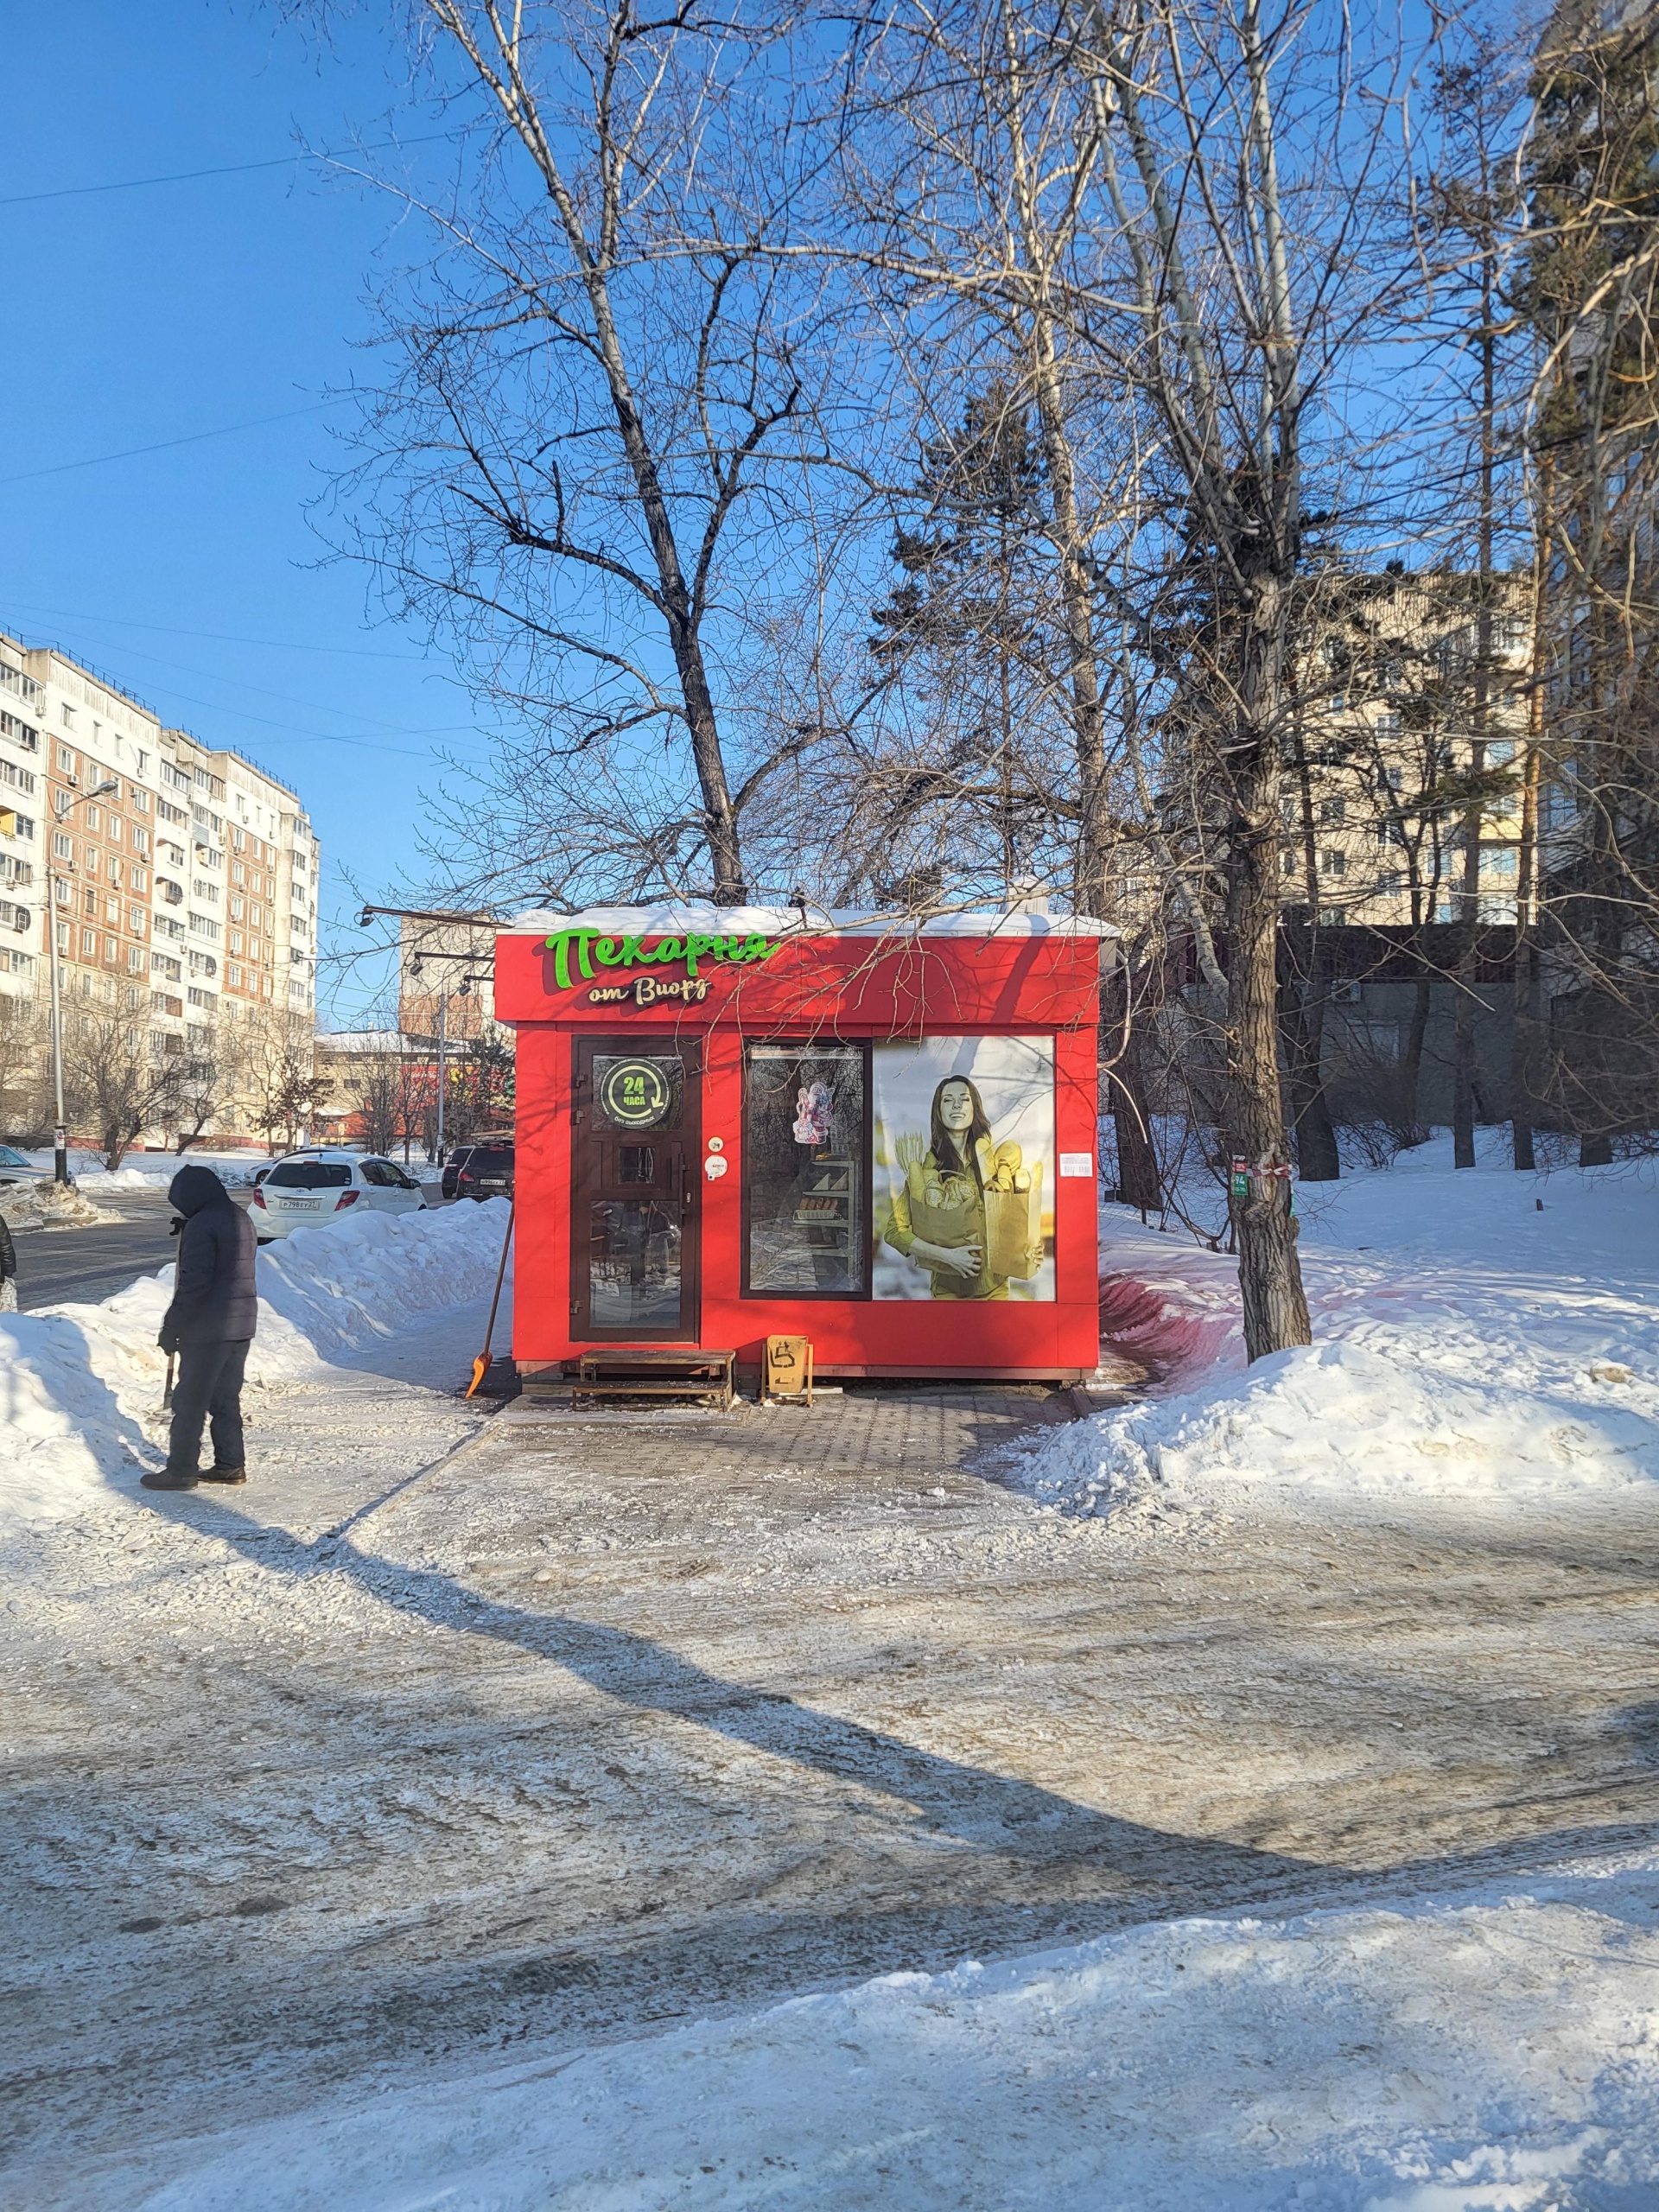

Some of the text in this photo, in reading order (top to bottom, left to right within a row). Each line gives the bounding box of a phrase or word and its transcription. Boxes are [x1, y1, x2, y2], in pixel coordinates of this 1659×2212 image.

[545, 927, 781, 988] Пекарня
[588, 988, 629, 1002] от
[623, 1076, 645, 1095] 24
[623, 1096, 646, 1106] ЧАСА
